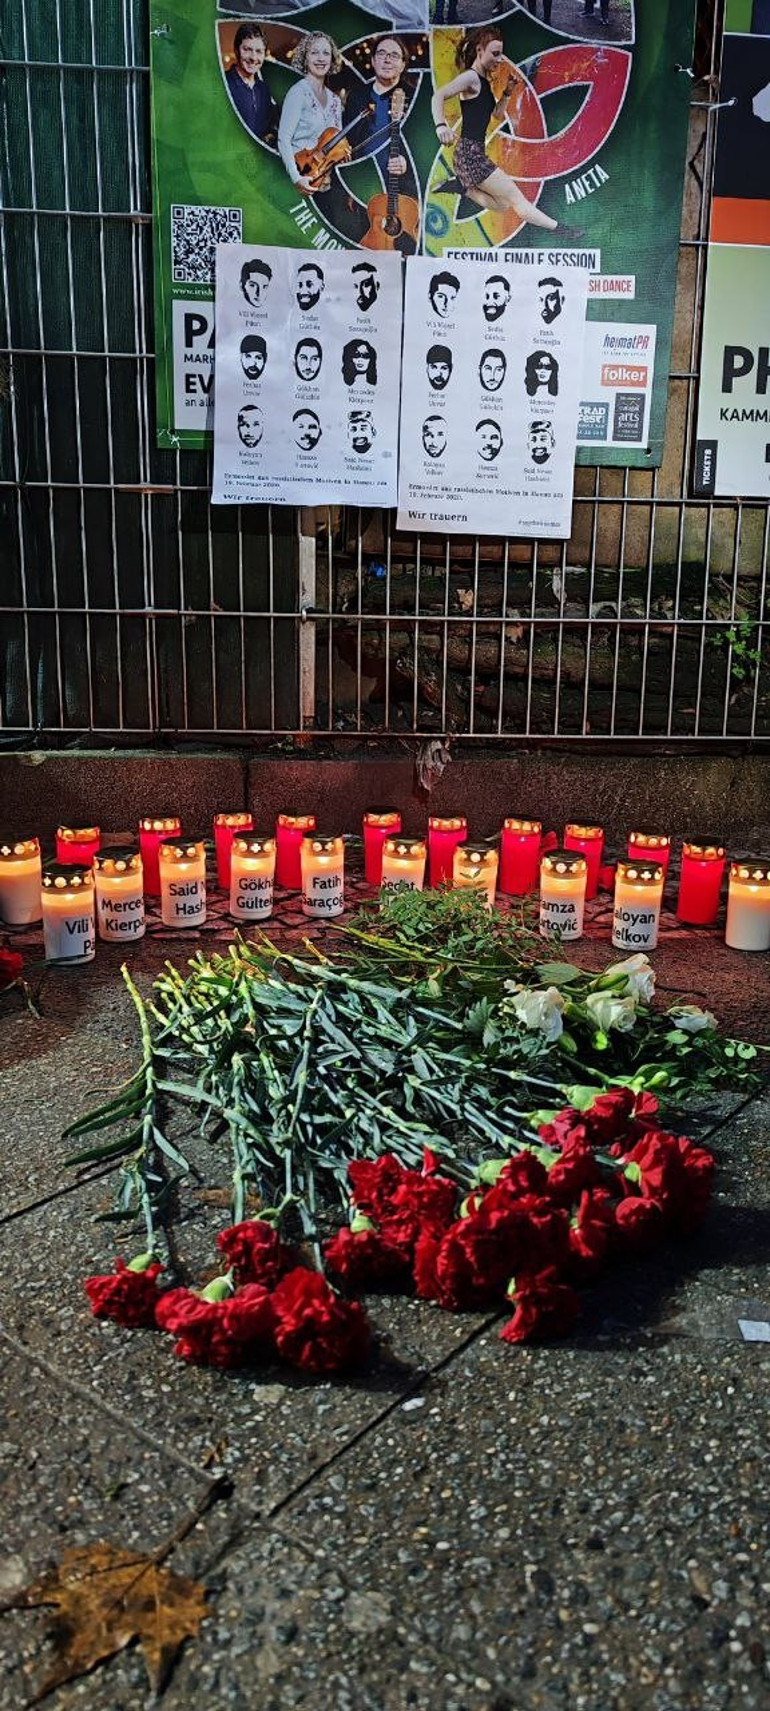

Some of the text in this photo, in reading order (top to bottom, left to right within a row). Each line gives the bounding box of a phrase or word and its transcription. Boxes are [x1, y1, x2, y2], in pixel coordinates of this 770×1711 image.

[563, 162, 611, 206] ANETA
[289, 198, 319, 235] THE
[547, 253, 596, 270] SESSION
[603, 279, 632, 293] DANCE
[603, 334, 650, 350] heimatPR
[603, 367, 646, 382] folker
[185, 398, 196, 407] an
[618, 412, 640, 422] arts
[719, 407, 770, 423] KAMM
[702, 448, 713, 486] TICKETS
[408, 510, 468, 522] Wir trauern
[168, 881, 198, 897] Said
[312, 874, 342, 890] Fatih
[64, 918, 89, 935] Vili
